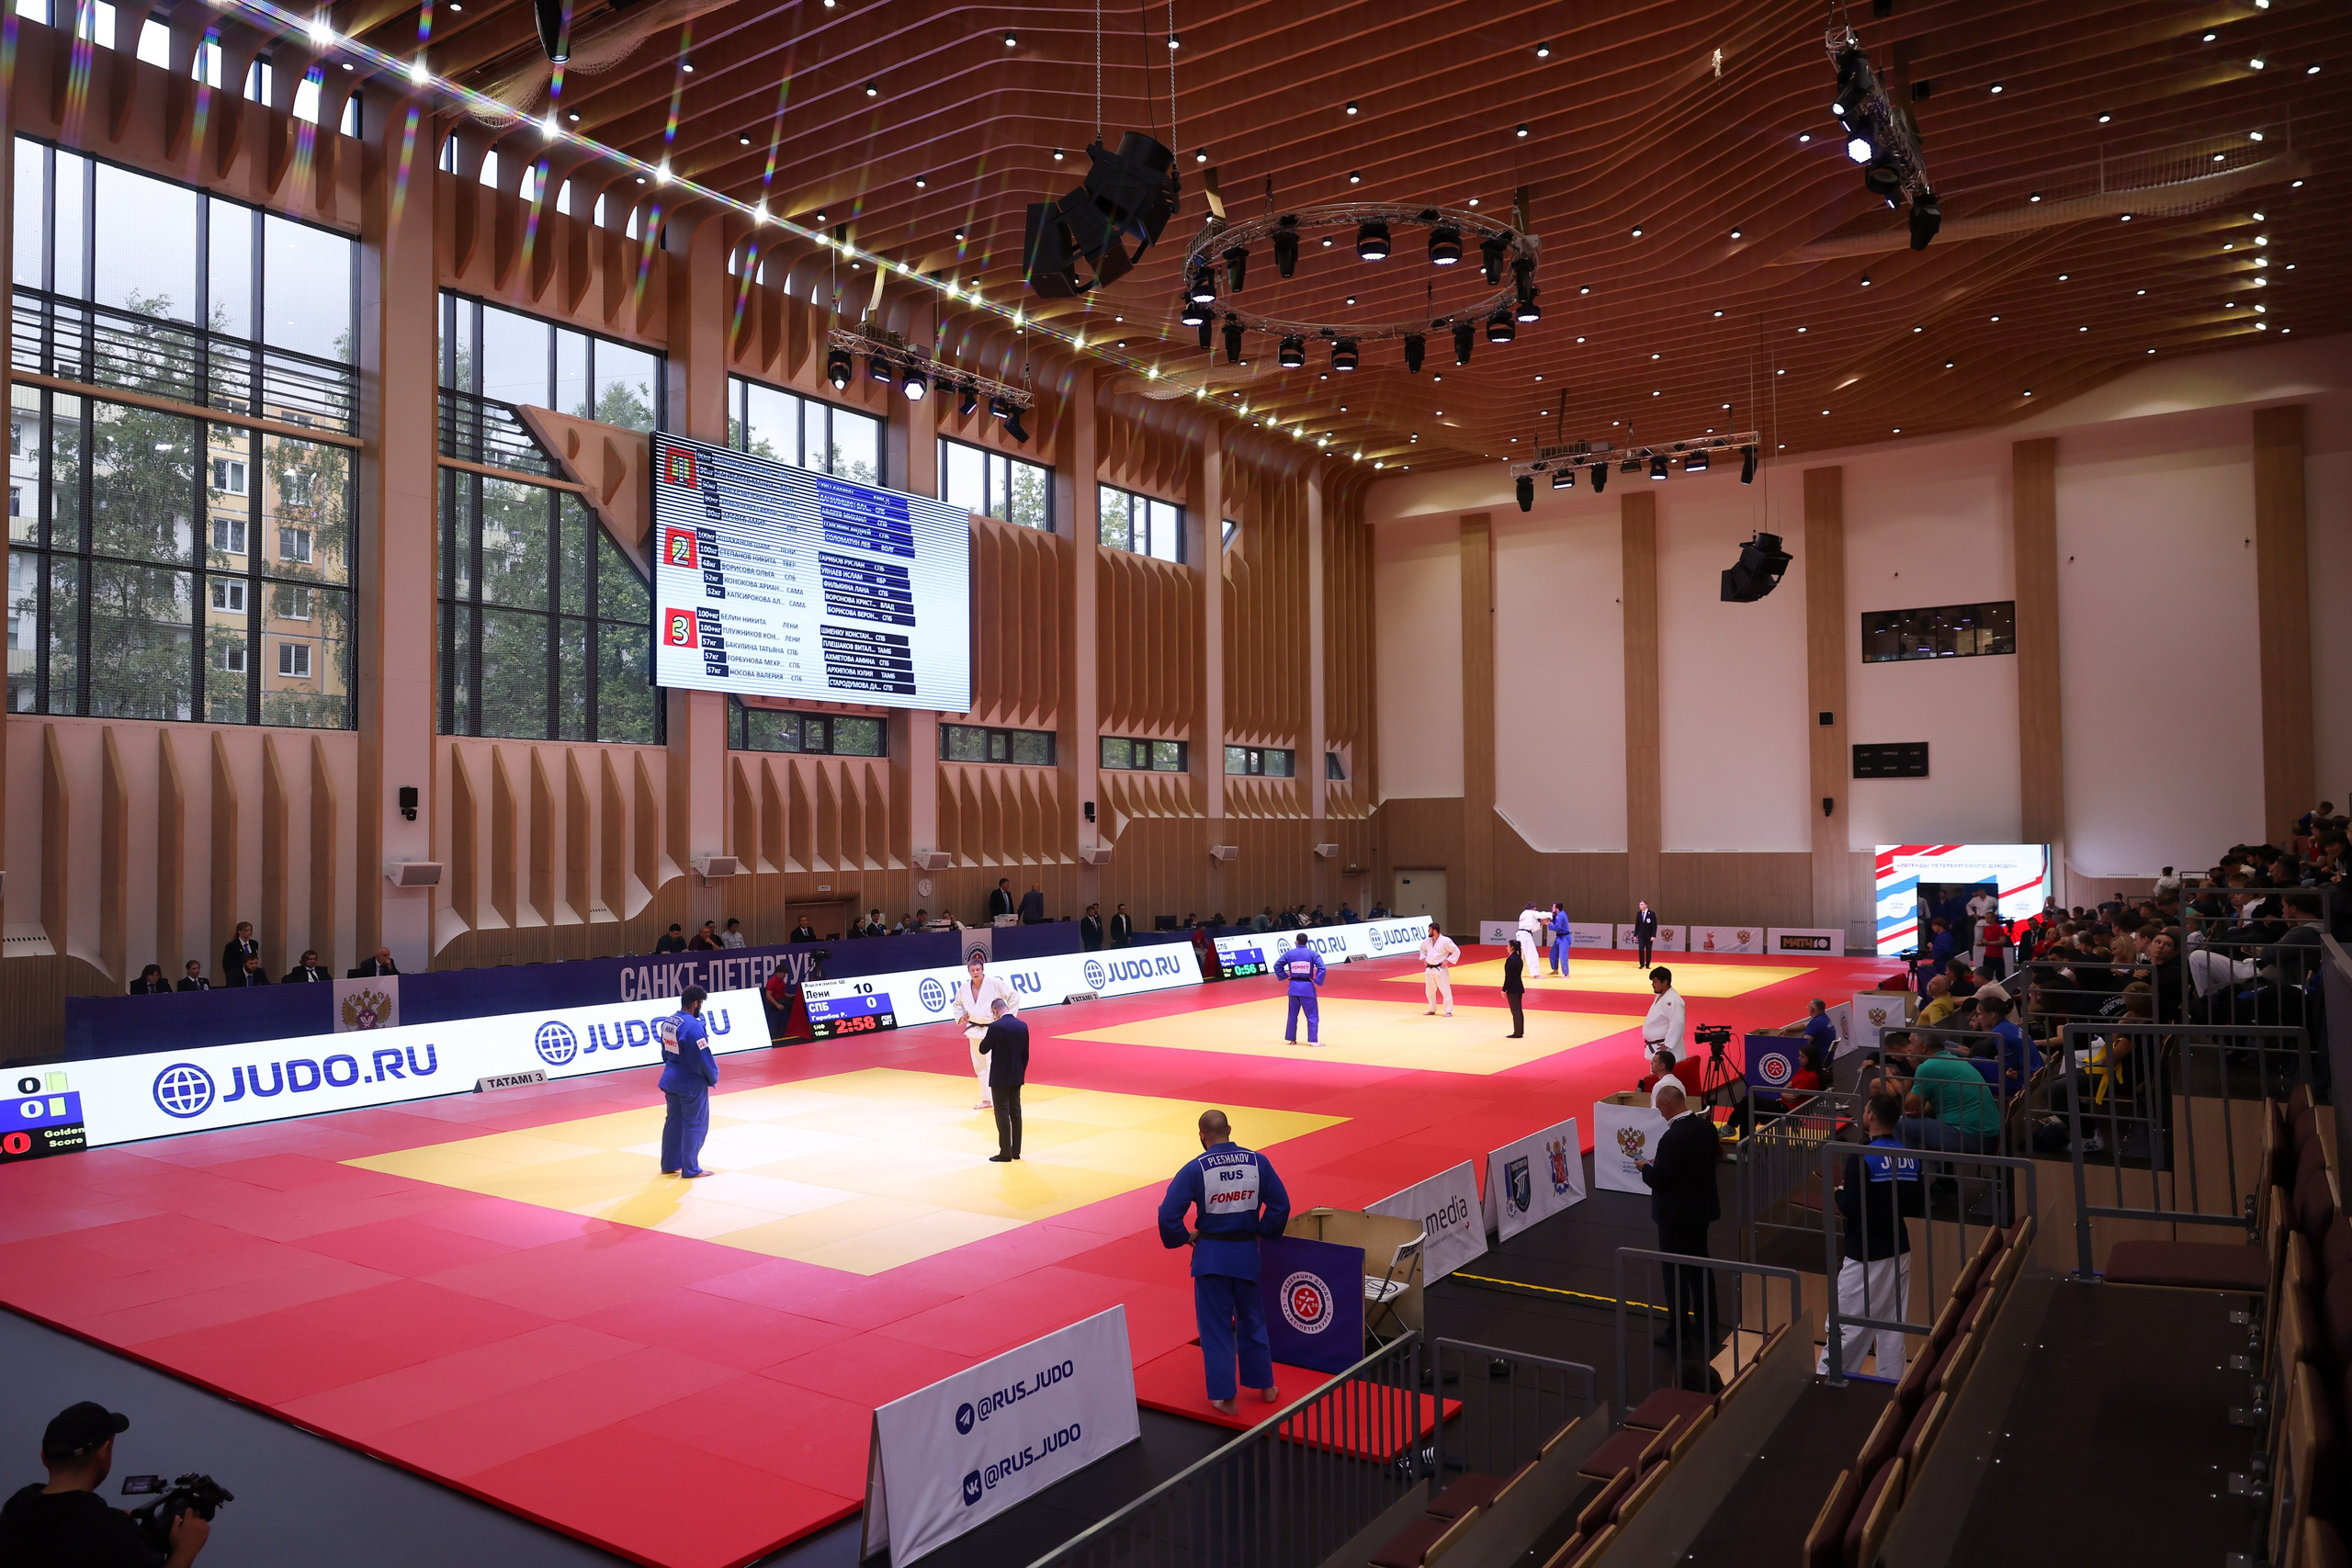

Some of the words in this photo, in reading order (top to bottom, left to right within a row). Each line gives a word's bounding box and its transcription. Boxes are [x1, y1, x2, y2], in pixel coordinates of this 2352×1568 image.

[673, 456, 688, 486] 1
[697, 531, 716, 541] 100кг
[851, 526, 872, 536] АНДРЕЙ
[672, 536, 689, 566] 2
[825, 534, 860, 547] СОЛОМАТИН
[880, 545, 895, 553] ВОЛГ
[700, 545, 718, 555] 100кг
[718, 549, 752, 560] СТЕПАНОВ
[752, 556, 777, 565] НИКИТА
[819, 554, 843, 565] ГАРИБОВ
[844, 559, 865, 569] РУСЛАН
[702, 558, 717, 568] 48кг
[721, 562, 754, 575] БОРИСОВА
[755, 569, 775, 579] ОЛЬГА
[843, 571, 864, 581] ИСЛАМ
[705, 573, 719, 581] 52кг
[724, 577, 758, 588] КОНОКОВА
[786, 587, 804, 595] САМА
[823, 581, 854, 592] ФИЛЬКИНА
[854, 586, 870, 594] ЛАНА
[707, 588, 721, 596] 52кг
[726, 591, 771, 604] ХАПСИРОКОВА
[788, 601, 806, 609] САМА
[825, 593, 856, 604] ВОРОНОВА
[880, 603, 895, 612] ВЛАД
[697, 609, 719, 620] 100+кг
[720, 613, 741, 622] БЕЛИН
[742, 616, 766, 626] НИКИТА
[783, 622, 798, 630] ЛЕНИ
[827, 606, 856, 617] БОРИСОВА
[672, 615, 689, 645] 3
[699, 624, 721, 634] 100+кг
[723, 627, 763, 638] ПЛУЖНИКОВ
[785, 635, 801, 643] ЛЕНИ
[876, 634, 886, 642] СПБ
[702, 637, 717, 647] 57кг
[725, 640, 758, 651] БАКУЛИНА
[758, 645, 785, 654] ТАТЬЯНА
[823, 639, 854, 650] ПЛЕШАКОВ
[877, 647, 892, 655] ТАМБ
[704, 651, 719, 660] 57кг
[727, 655, 763, 666] ГОРБУНОВА
[825, 652, 854, 663] АХМЕТОВА
[854, 656, 876, 665] АМИНА
[707, 666, 722, 674] 57кг
[729, 668, 755, 678] НОСОВА
[756, 671, 784, 681] ВАЛЕРИЯ
[827, 665, 857, 676] АРХИПОВА
[856, 670, 874, 678] ЮЛИЯ
[880, 671, 896, 680] ТАМБ
[829, 679, 869, 691] СТАРОДУМОВА
[1383, 926, 1428, 945] JUDO.RU
[1216, 942, 1227, 951] СПБ
[1250, 950, 1256, 958] 1
[1108, 954, 1182, 984] JUDO.RU
[1234, 963, 1258, 976] 0:56
[806, 990, 831, 999] Лени
[854, 983, 874, 995] 10
[1071, 995, 1093, 1003] TATAMI
[808, 1001, 830, 1013] СПБ
[865, 997, 877, 1009] 0
[811, 1012, 840, 1021] Гарибов
[834, 1015, 876, 1034] 2:58
[223, 1043, 438, 1102] JUDO.RU
[487, 1074, 533, 1088] TATAMI
[535, 1073, 544, 1082] 3
[17, 1077, 41, 1094] 0
[20, 1100, 45, 1119] 0
[44, 1127, 85, 1138] Golden
[49, 1137, 84, 1147] Score
[1207, 1153, 1250, 1167] PLESHAKOV
[1219, 1169, 1244, 1181] RUS
[1209, 1190, 1255, 1204] FONBET
[1283, 1274, 1313, 1293] ФЕДЕРАЦИЯ
[1314, 1279, 1330, 1302] ДЗЮДО
[1283, 1303, 1331, 1332] САНКТ-ПЕТЕРБУРГА
[978, 1359, 1074, 1421] @RUS_JUDO
[984, 1423, 1081, 1490] @RUS_JUDO
